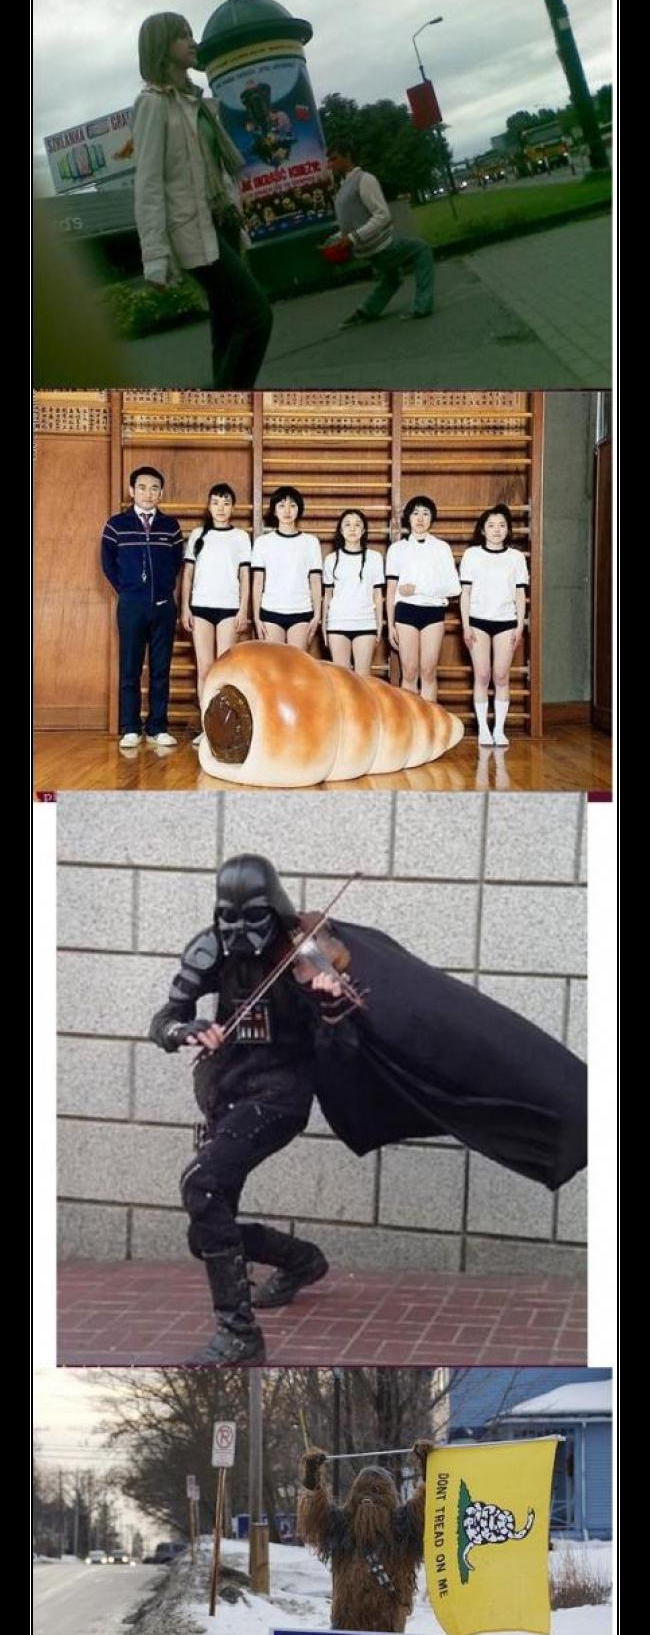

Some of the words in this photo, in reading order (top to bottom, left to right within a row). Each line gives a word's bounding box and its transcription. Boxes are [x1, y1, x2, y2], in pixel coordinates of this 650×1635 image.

[436, 1473, 449, 1500] DONT
[433, 1507, 446, 1547] TREAD
[435, 1554, 446, 1572] ON
[438, 1579, 448, 1598] ME
